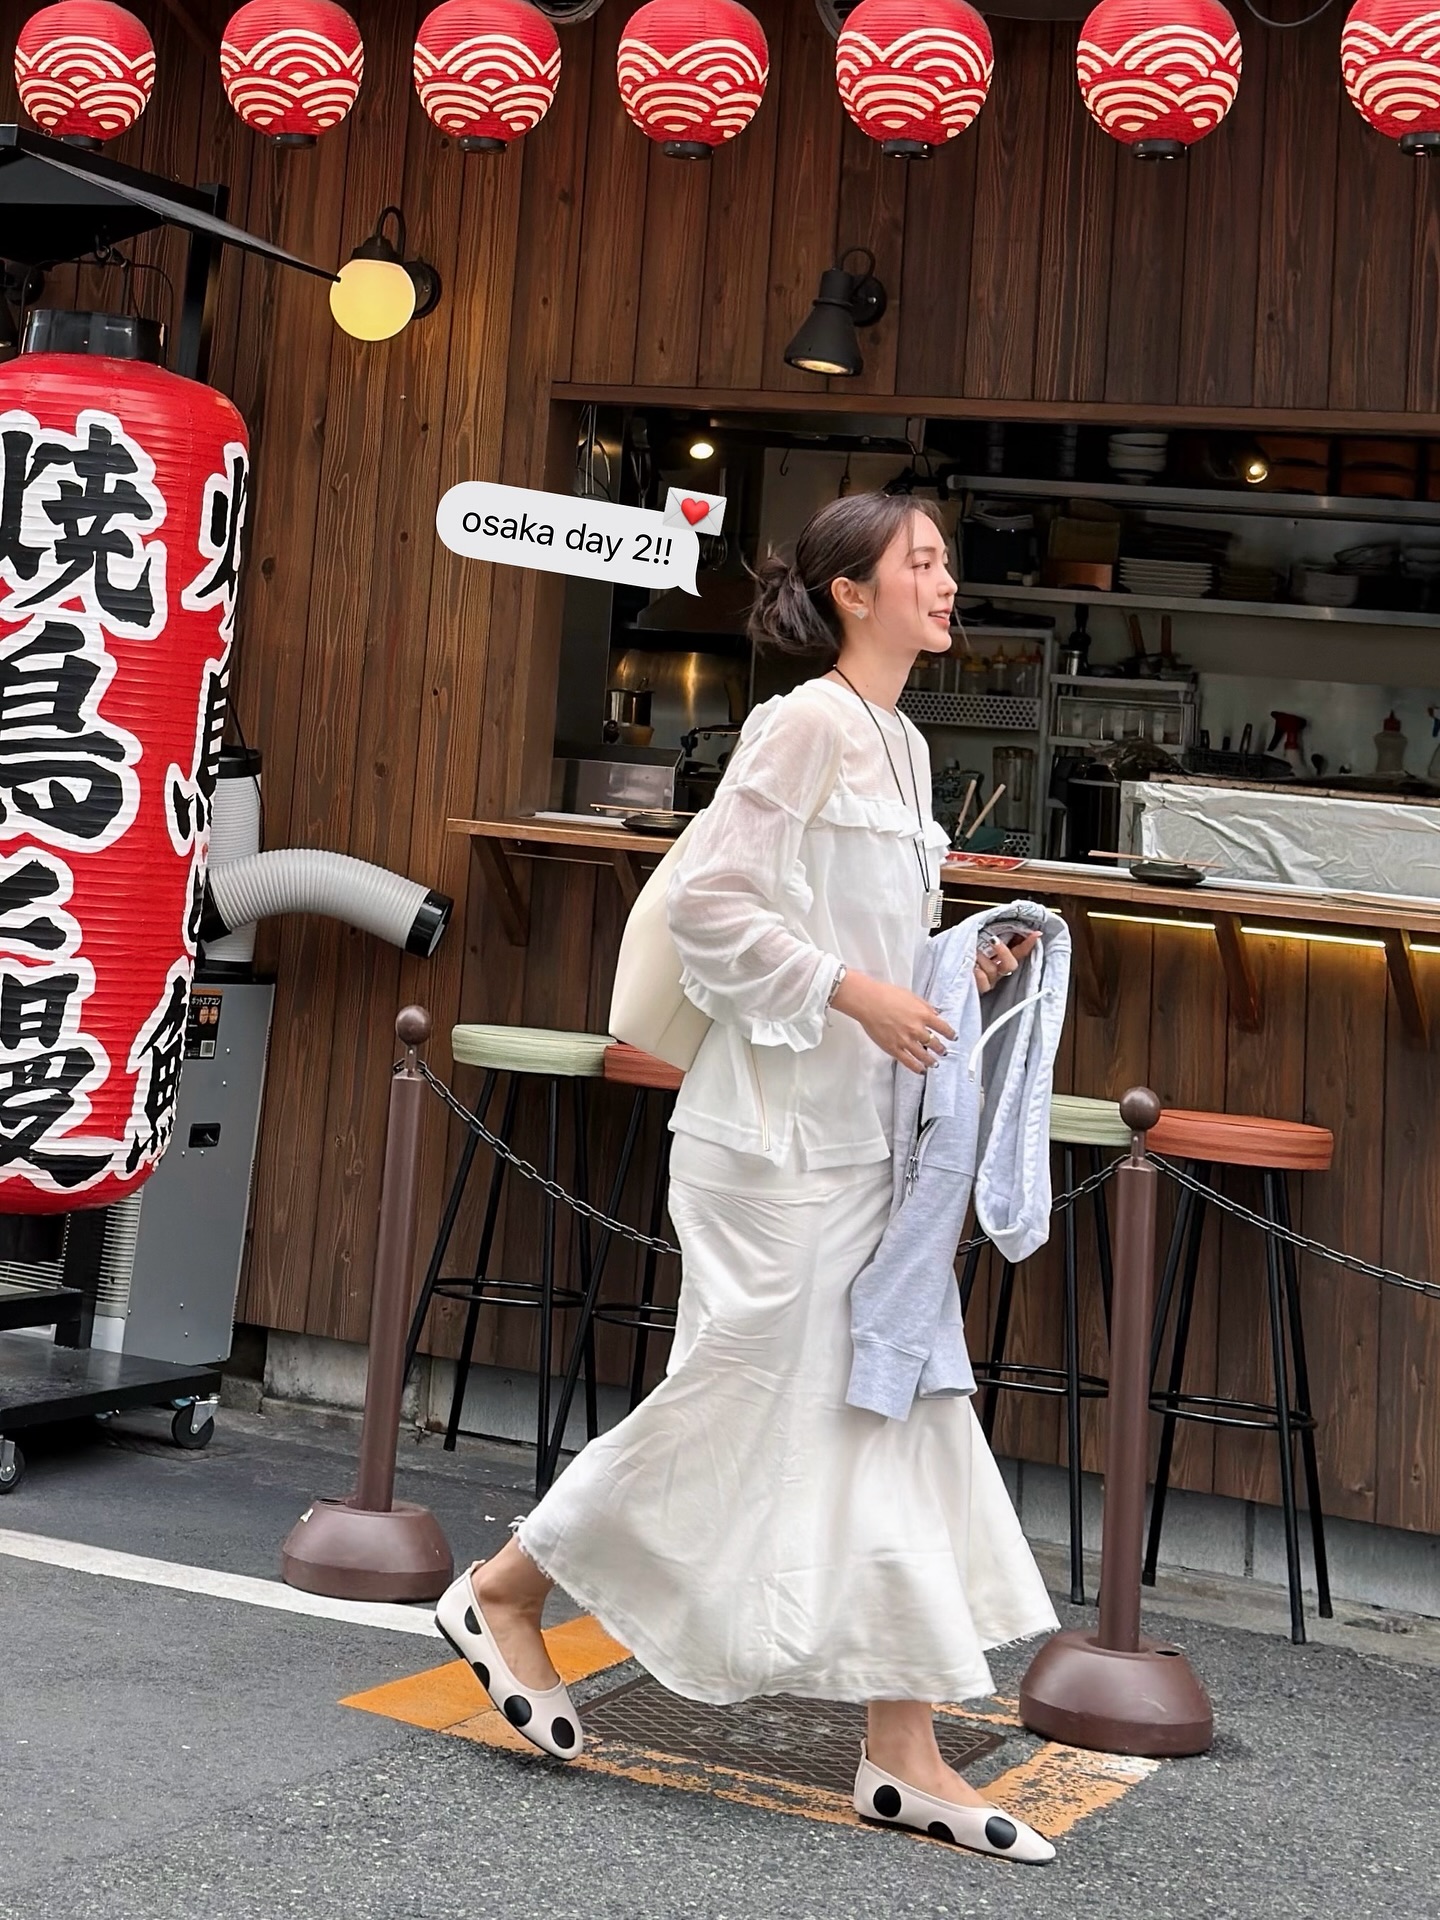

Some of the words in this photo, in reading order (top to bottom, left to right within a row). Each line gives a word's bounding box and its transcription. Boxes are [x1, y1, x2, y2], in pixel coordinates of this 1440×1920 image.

[191, 996, 221, 1006] ポットエアコン
